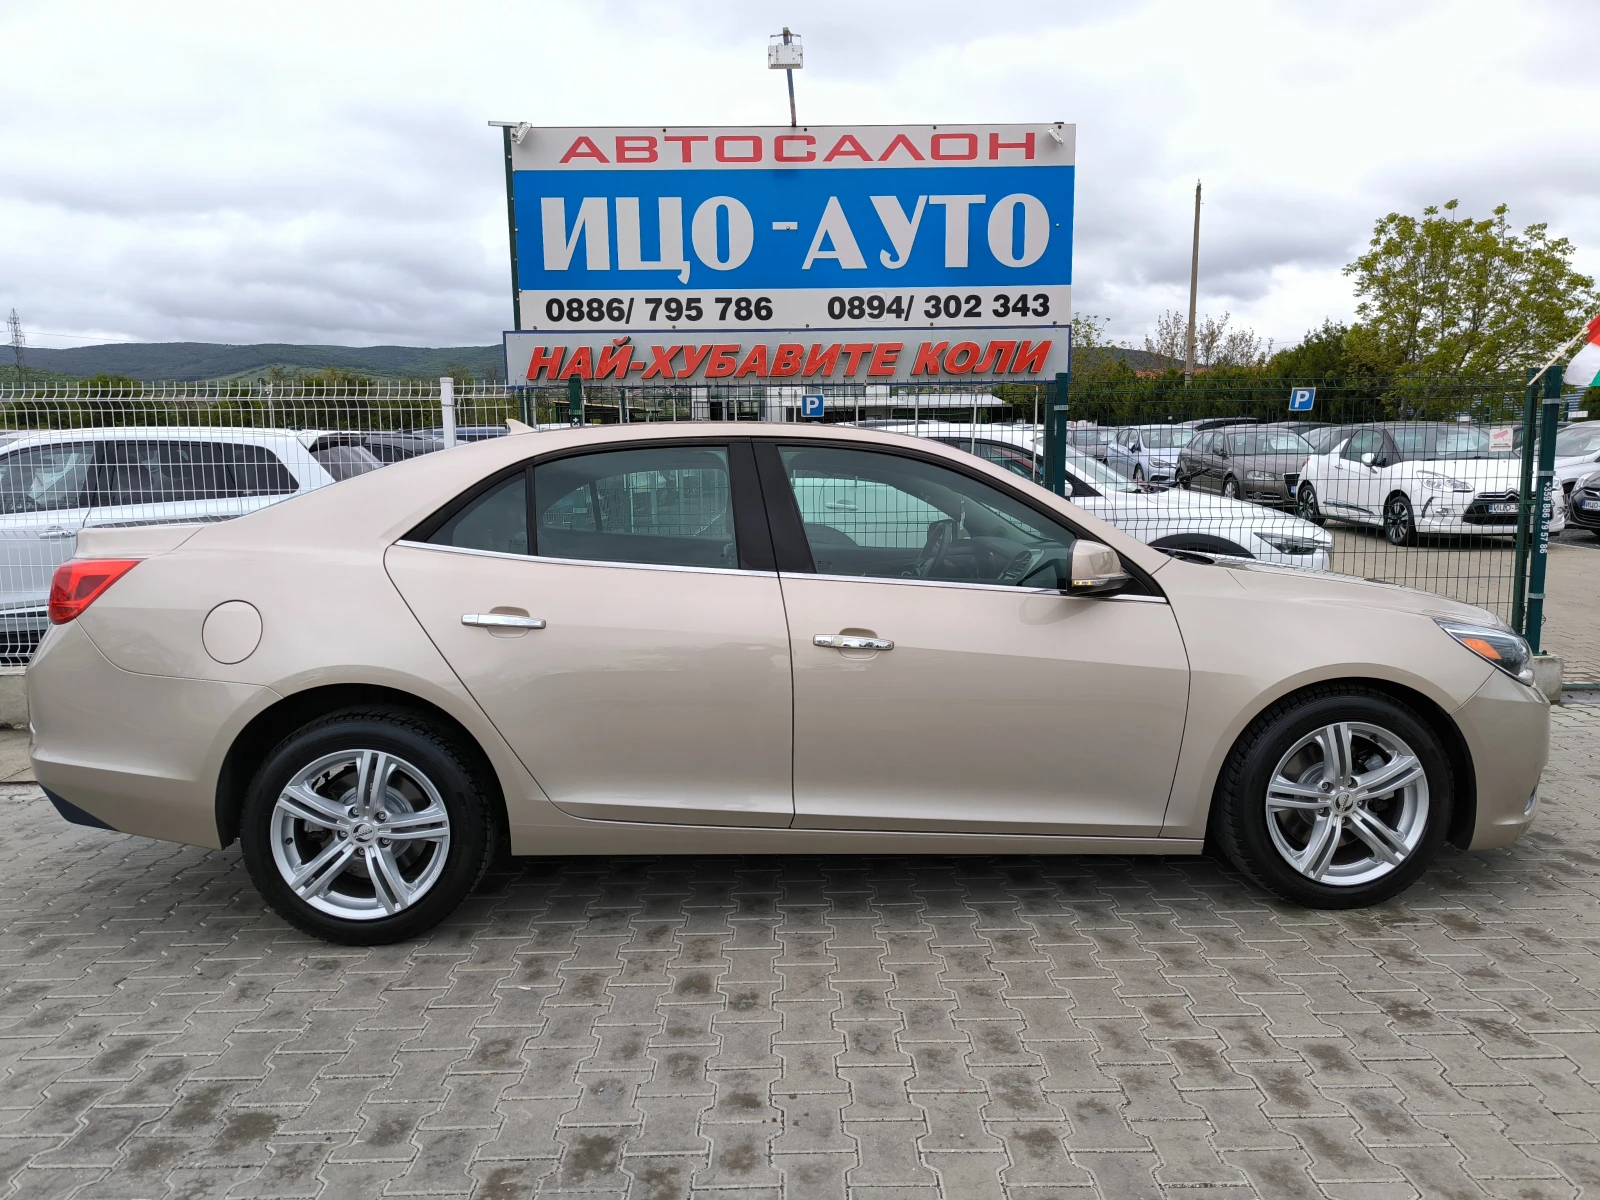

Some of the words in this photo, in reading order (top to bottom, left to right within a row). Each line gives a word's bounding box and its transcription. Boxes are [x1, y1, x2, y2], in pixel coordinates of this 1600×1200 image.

[558, 132, 1036, 164] АВТОСАЛОН
[545, 297, 635, 325] 0886/
[644, 297, 704, 321] 795
[715, 296, 774, 321] 786
[827, 294, 915, 321] 0894/
[923, 294, 982, 319] 302
[992, 293, 1050, 318] 343
[525, 335, 904, 380] НАЙ-ХУБАВИТЕ
[910, 339, 1053, 376] КОЛИ
[806, 397, 820, 415] P
[1294, 390, 1310, 408] P
